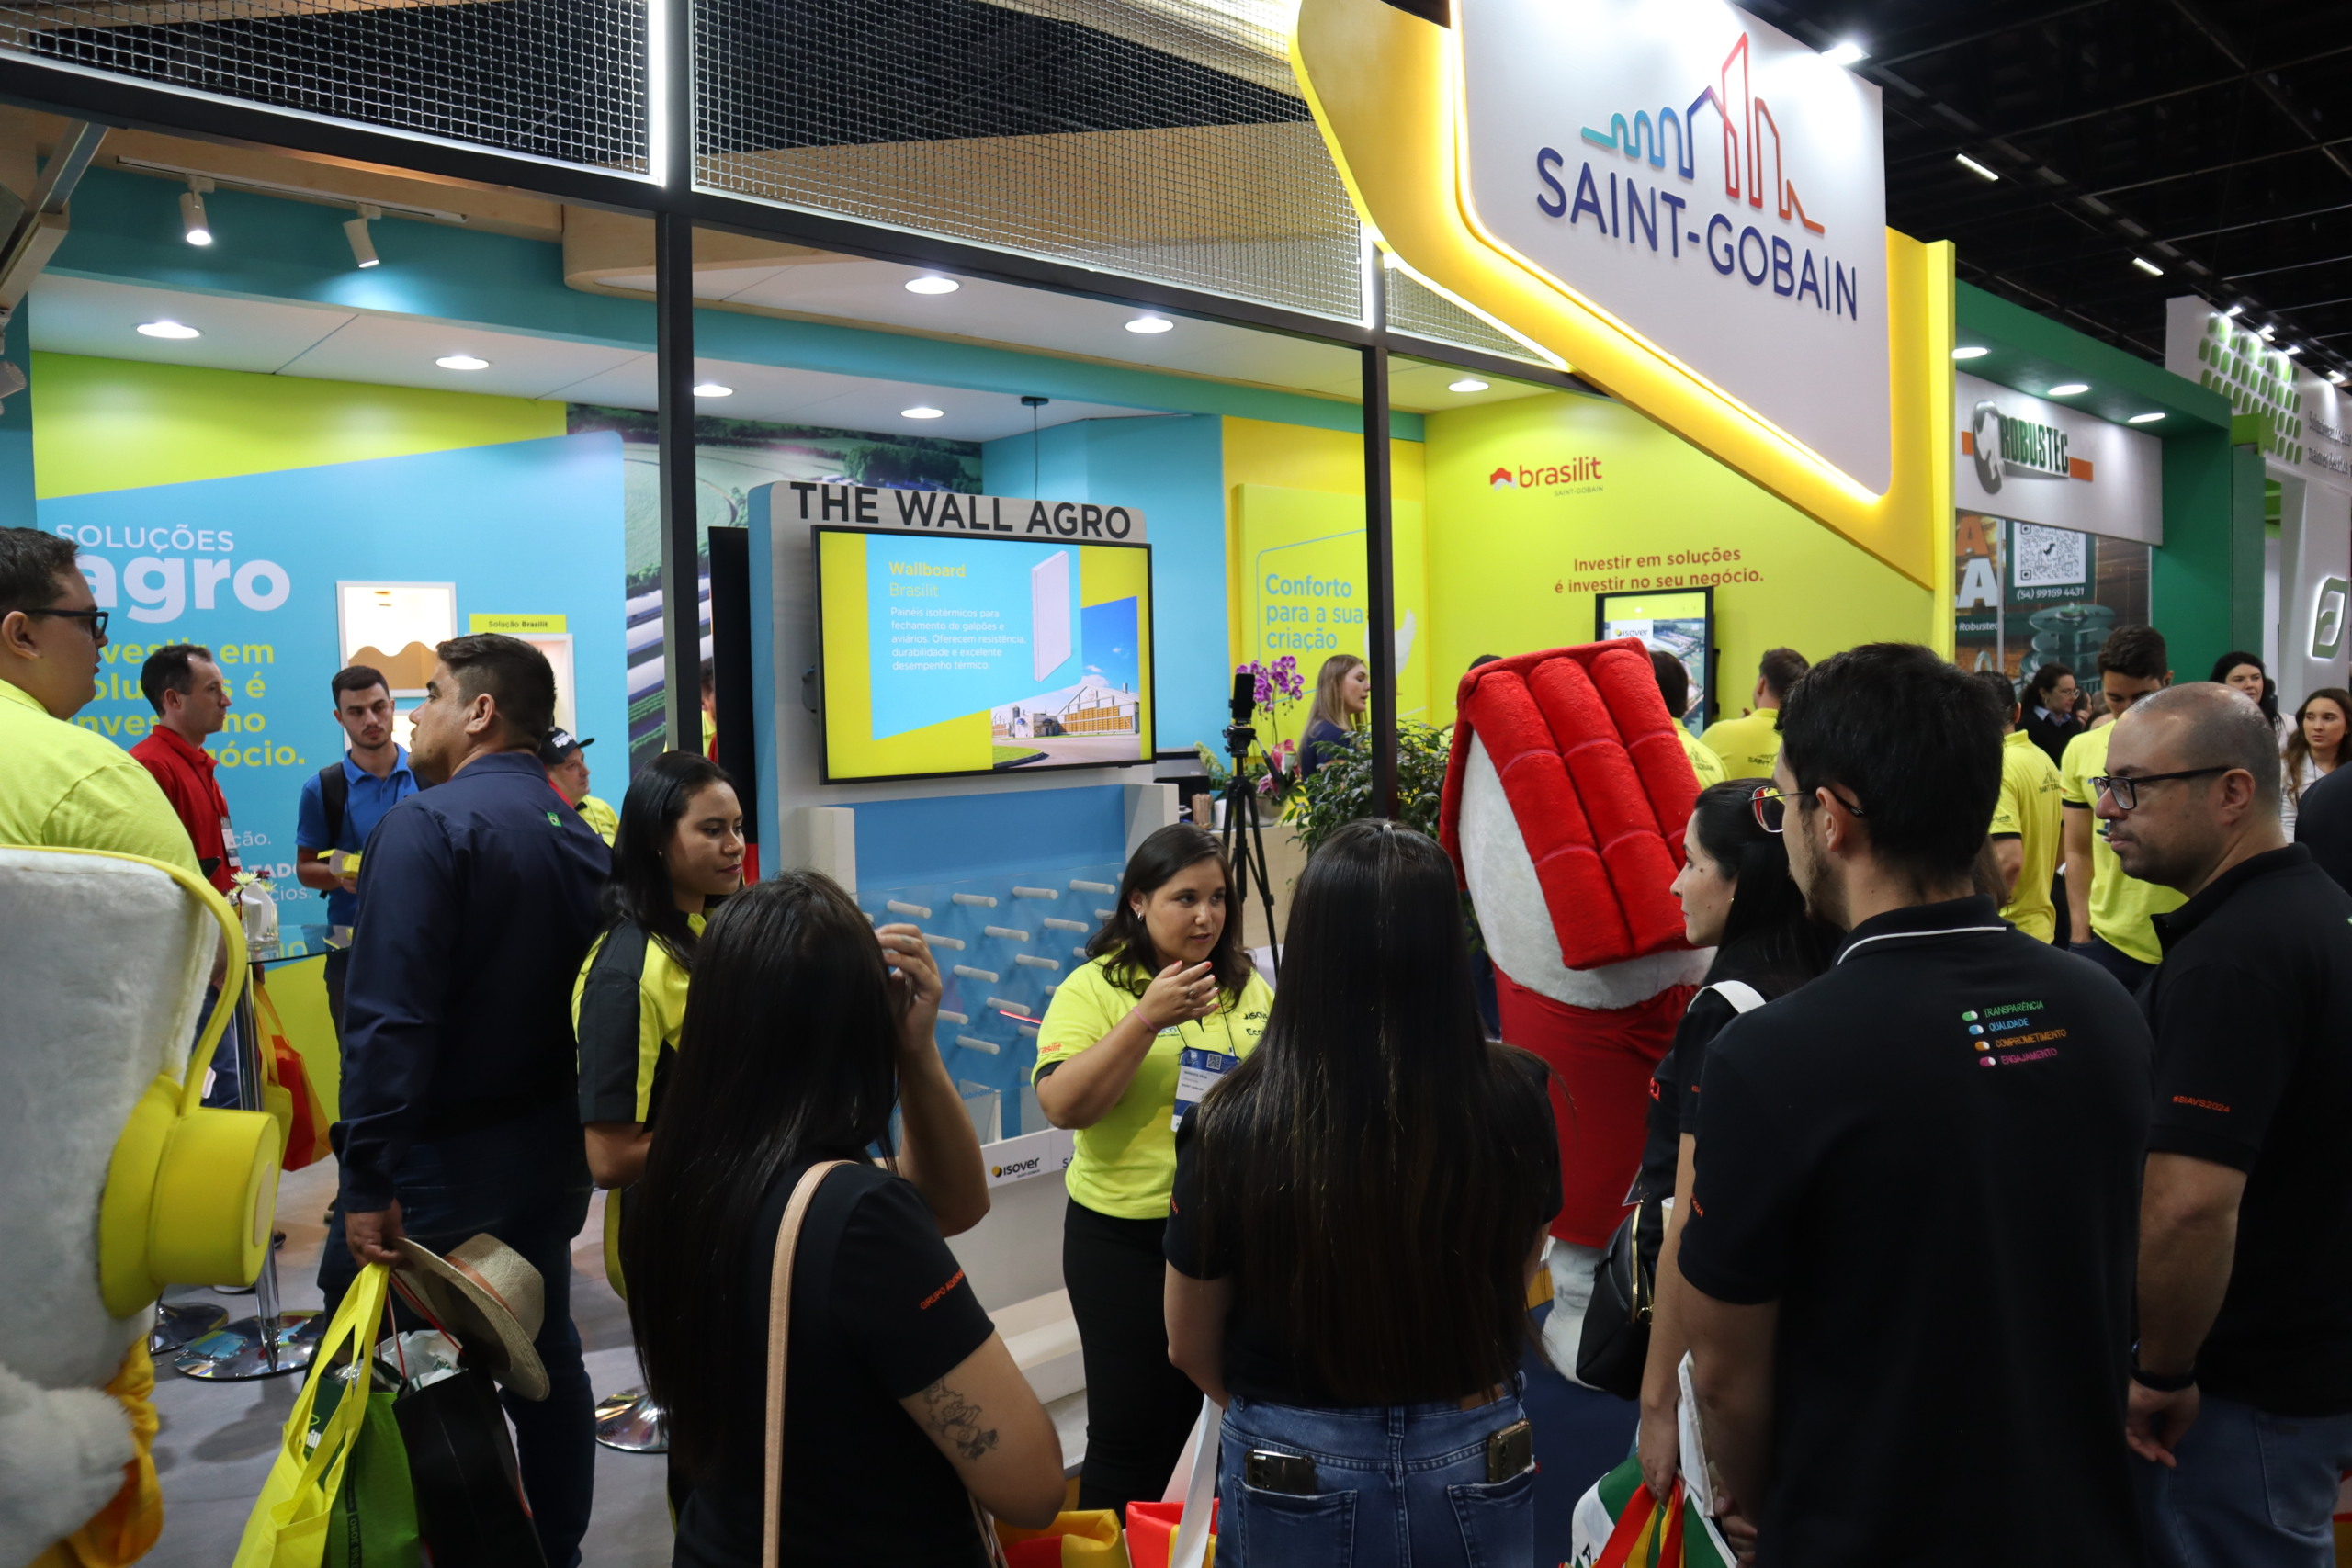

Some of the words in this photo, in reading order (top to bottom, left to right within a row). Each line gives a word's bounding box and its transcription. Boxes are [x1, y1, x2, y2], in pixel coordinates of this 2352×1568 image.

[1537, 147, 1857, 321] SAINT-GOBAIN
[1999, 413, 2069, 474] ROBUSTEC
[1519, 457, 1602, 488] brasilit
[1554, 485, 1604, 497] SAINT-GOBAIN
[790, 482, 879, 523] THE
[895, 490, 1013, 532] WALL
[1026, 501, 1131, 538] AGRO
[55, 524, 234, 553] SOLUÇÕES
[1574, 555, 1632, 571] Investir
[1636, 556, 1661, 567] em
[1667, 547, 1741, 566] soluções
[888, 562, 967, 577] Wallboard
[75, 554, 290, 624] agro
[889, 583, 939, 597] Brasilit
[1265, 573, 1352, 598] Conforto
[1555, 580, 1563, 593] é
[1568, 576, 1625, 592] investir
[1631, 577, 1651, 589] no
[1657, 575, 1684, 588] seu
[1690, 568, 1764, 587] negócio.
[890, 607, 923, 616] Painéis
[926, 608, 978, 618] isotérmicos
[980, 611, 1000, 619] para
[1266, 605, 1309, 626] para
[1316, 606, 1326, 623] a
[1332, 607, 1363, 624] sua
[489, 620, 519, 628] Solução
[891, 621, 946, 630] fechamento
[949, 622, 960, 630] de
[963, 622, 997, 632] galpões
[891, 635, 928, 643] aviários.
[933, 635, 976, 644] Oferecem
[1266, 626, 1338, 653] criação
[220, 644, 274, 663] em
[892, 648, 949, 657] durabilidade
[960, 648, 1002, 656] excelente
[892, 661, 952, 671] desempenho
[245, 671, 266, 698] é
[222, 713, 266, 733] no
[1984, 1000, 2044, 1018] TRANSPARÊNCIA
[1988, 1018, 2030, 1032] QUALIDADE
[1995, 1029, 2067, 1048] COMPROMETIMENTO
[2000, 1048, 2058, 1065] ENGAJAMENTO
[1003, 1157, 1040, 1176] isover
[920, 1286, 946, 1309] GRUPO
